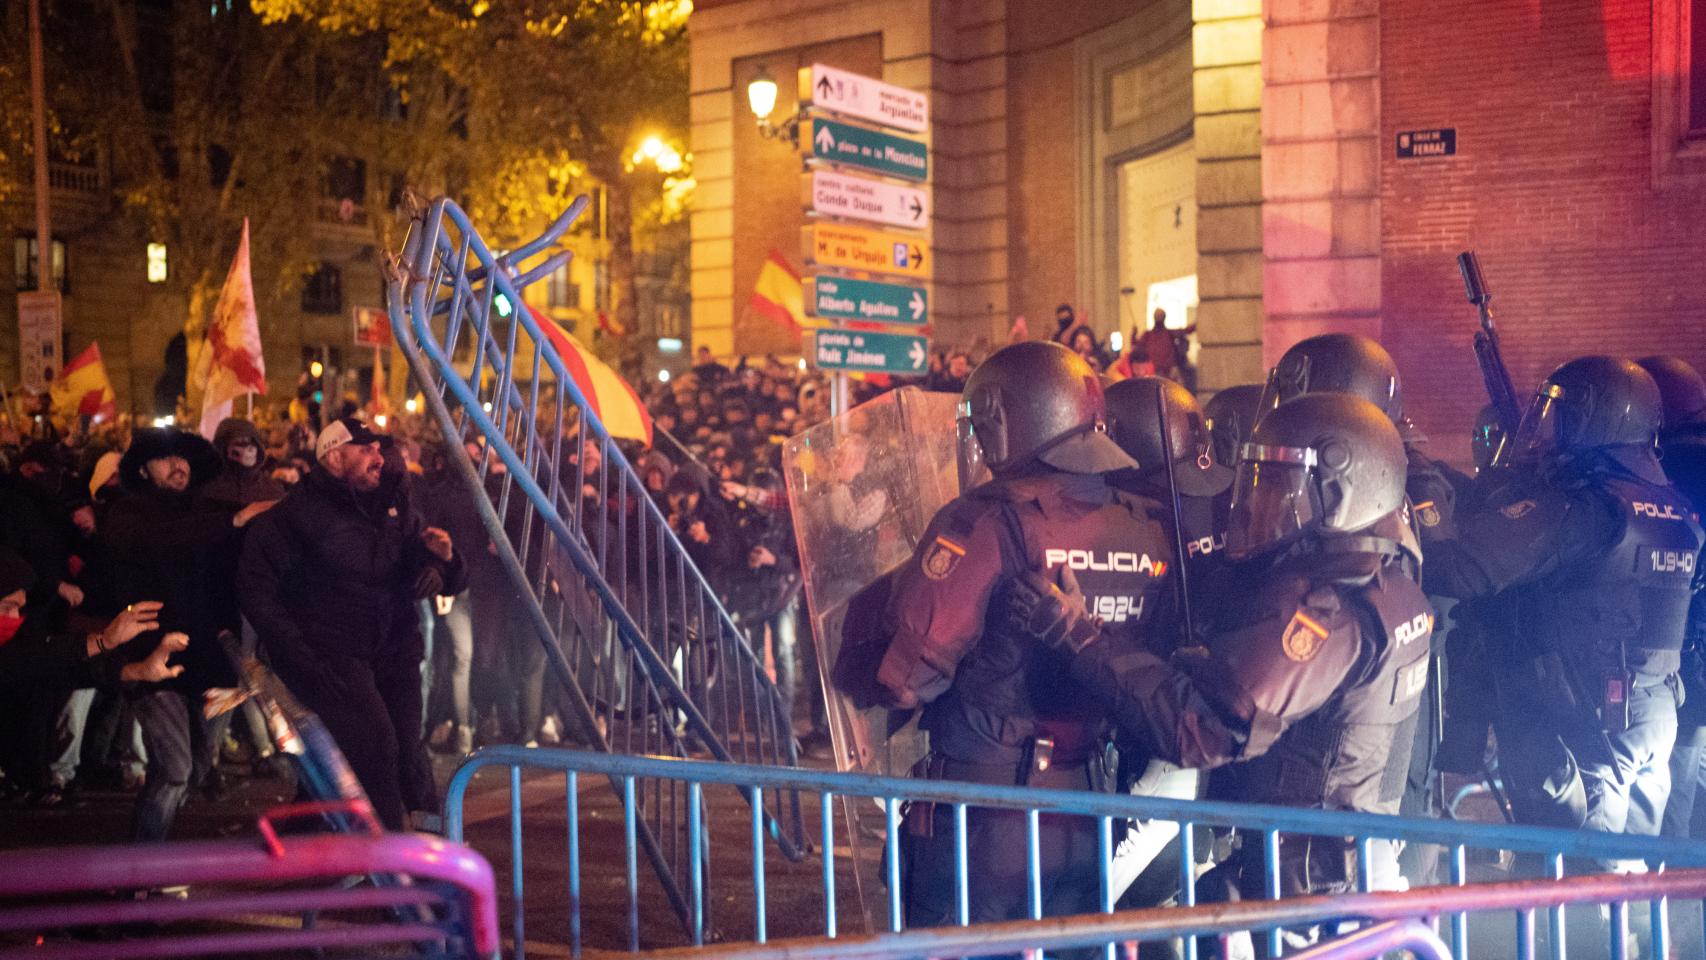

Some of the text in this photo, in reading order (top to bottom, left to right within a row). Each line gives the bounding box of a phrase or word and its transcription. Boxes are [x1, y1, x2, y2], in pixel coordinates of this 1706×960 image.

[885, 146, 925, 168] Moncloa
[817, 191, 883, 213] Conde Duque
[837, 247, 846, 257] de
[818, 296, 899, 317] Alberto Aguilera
[854, 336, 864, 347] de
[818, 347, 841, 363] Ruiz
[1632, 502, 1687, 520] POLIC
[1187, 532, 1227, 558] POLI
[1045, 549, 1153, 572] POLICIA
[1651, 551, 1693, 573] 1U940
[1082, 595, 1144, 622] U924
